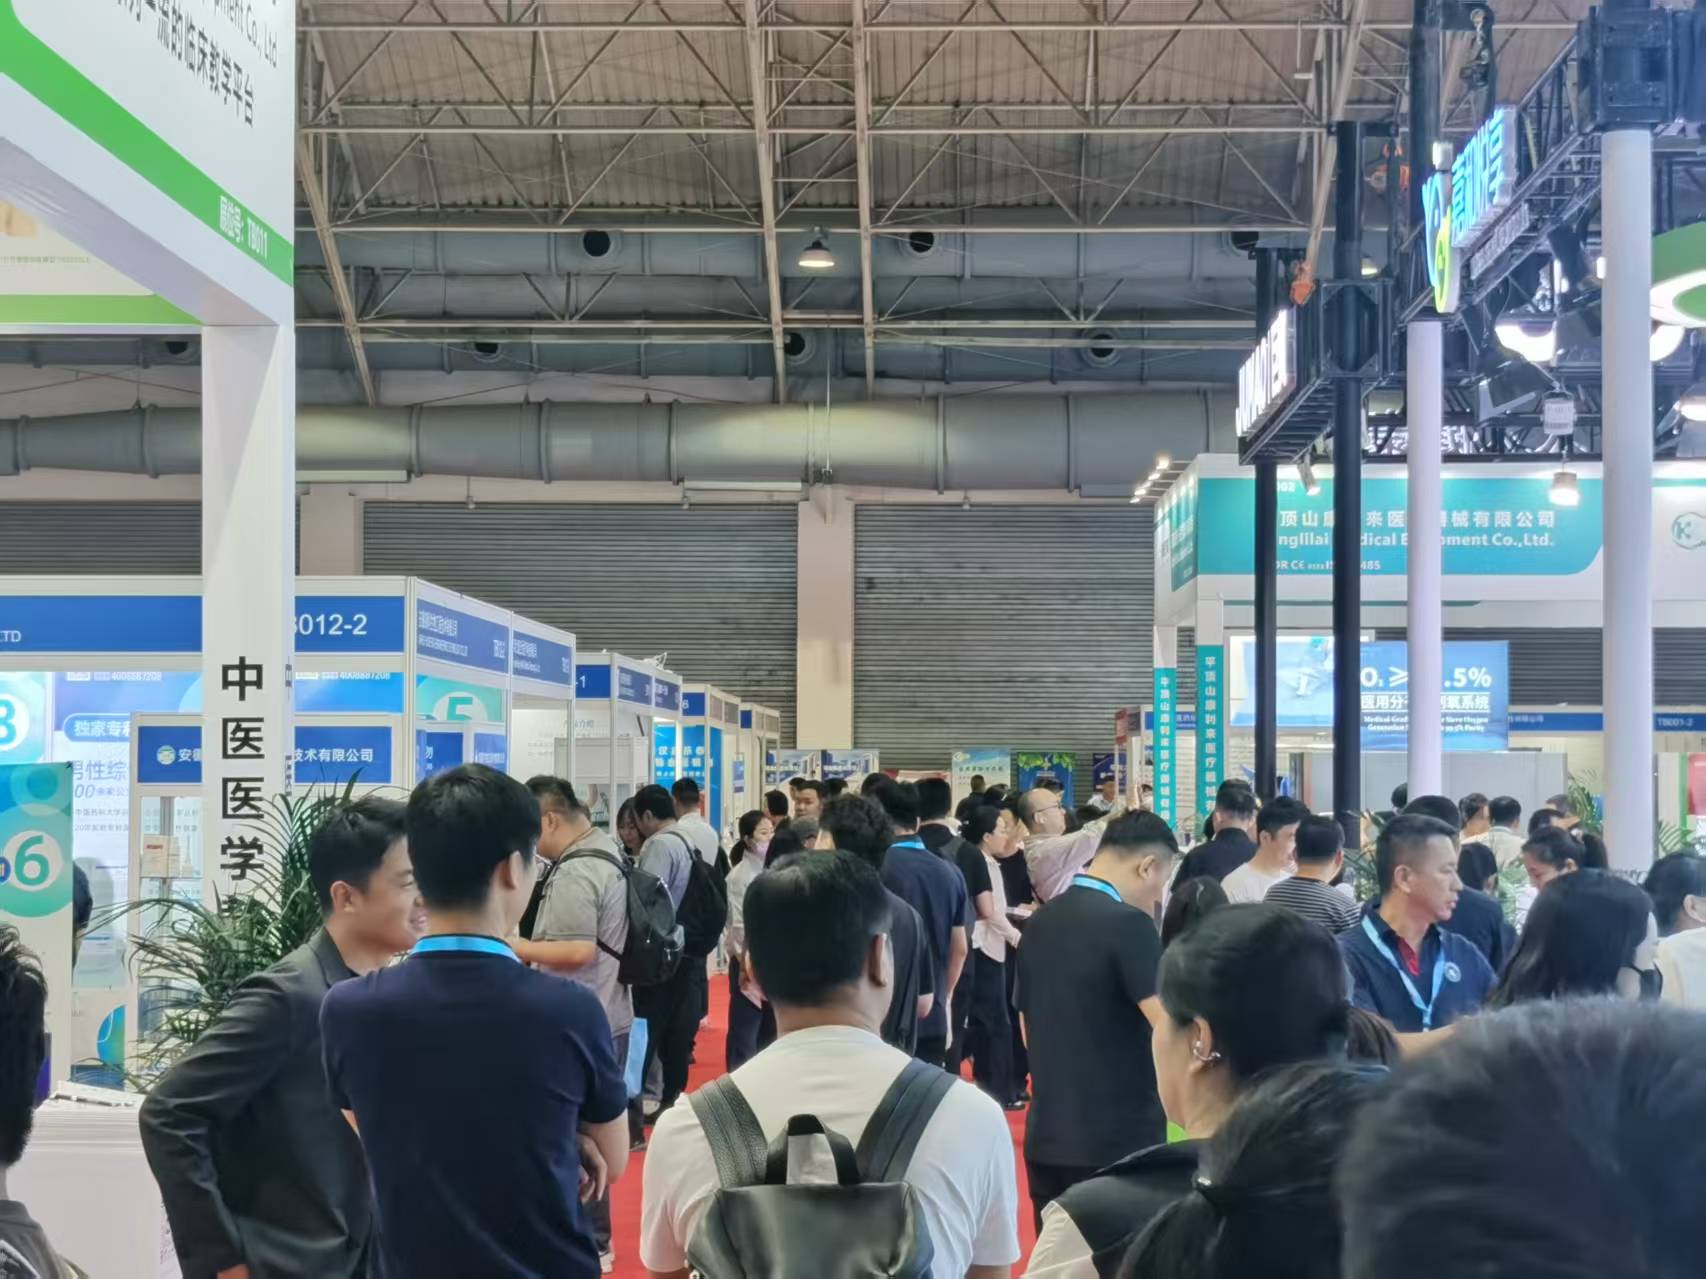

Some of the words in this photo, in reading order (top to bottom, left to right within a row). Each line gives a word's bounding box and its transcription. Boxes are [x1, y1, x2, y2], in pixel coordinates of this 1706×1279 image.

[1361, 532, 1397, 547] dical
[294, 613, 368, 635] 012-2
[1444, 667, 1492, 688] .5%
[14, 834, 50, 887] 6
